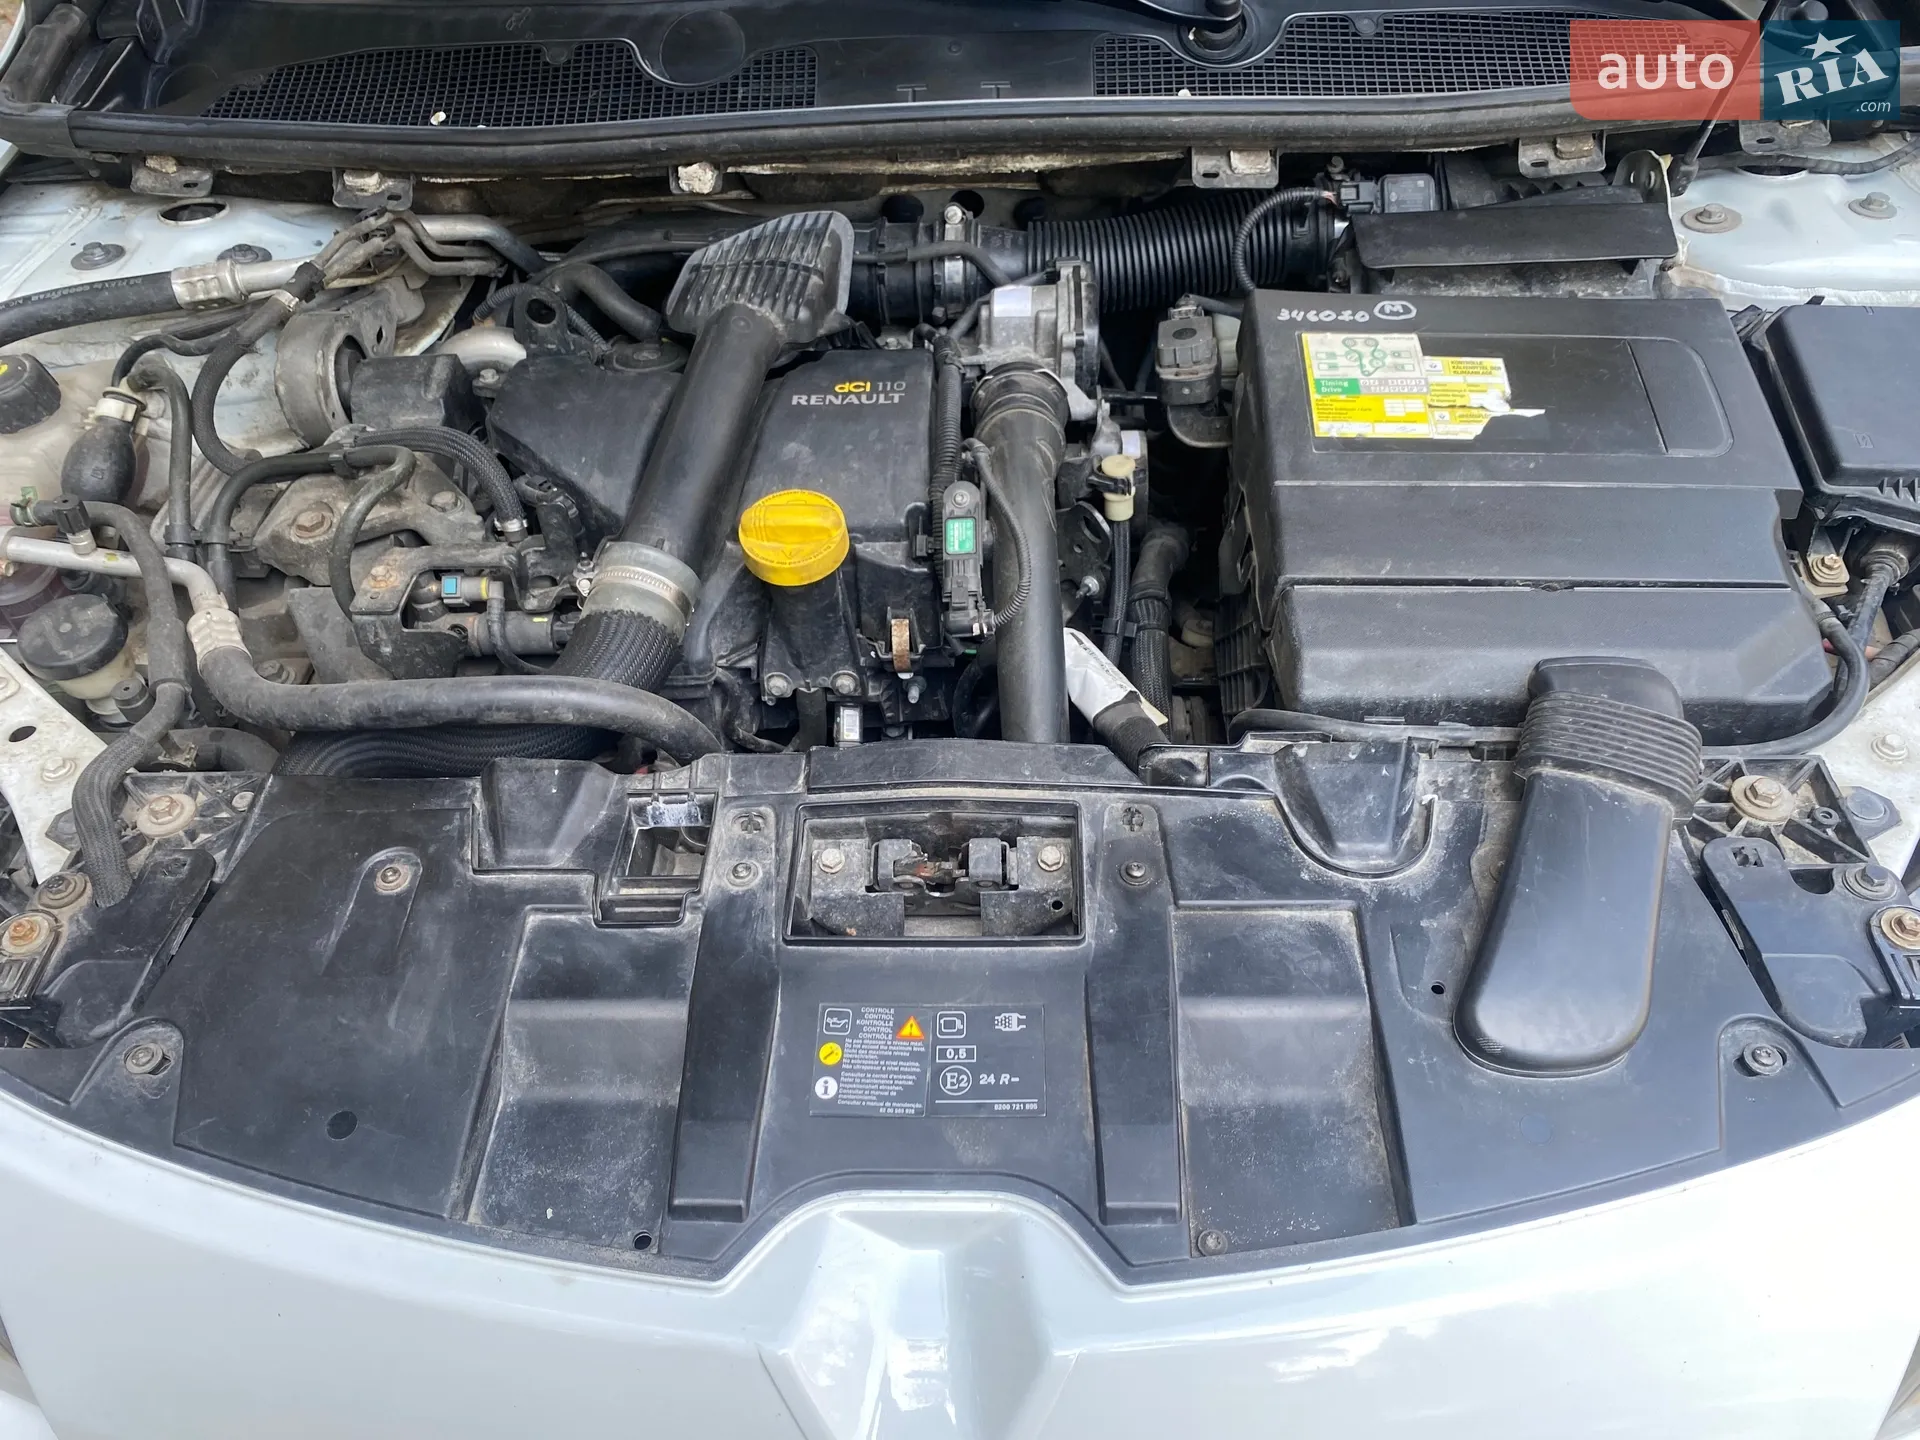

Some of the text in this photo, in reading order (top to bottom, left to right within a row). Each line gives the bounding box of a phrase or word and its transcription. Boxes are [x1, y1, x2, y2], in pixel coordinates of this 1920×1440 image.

[877, 381, 906, 391] 110
[791, 393, 905, 405] RENAULT
[946, 1048, 966, 1060] 0,5
[945, 1072, 968, 1089] E2
[979, 1073, 995, 1085] 24
